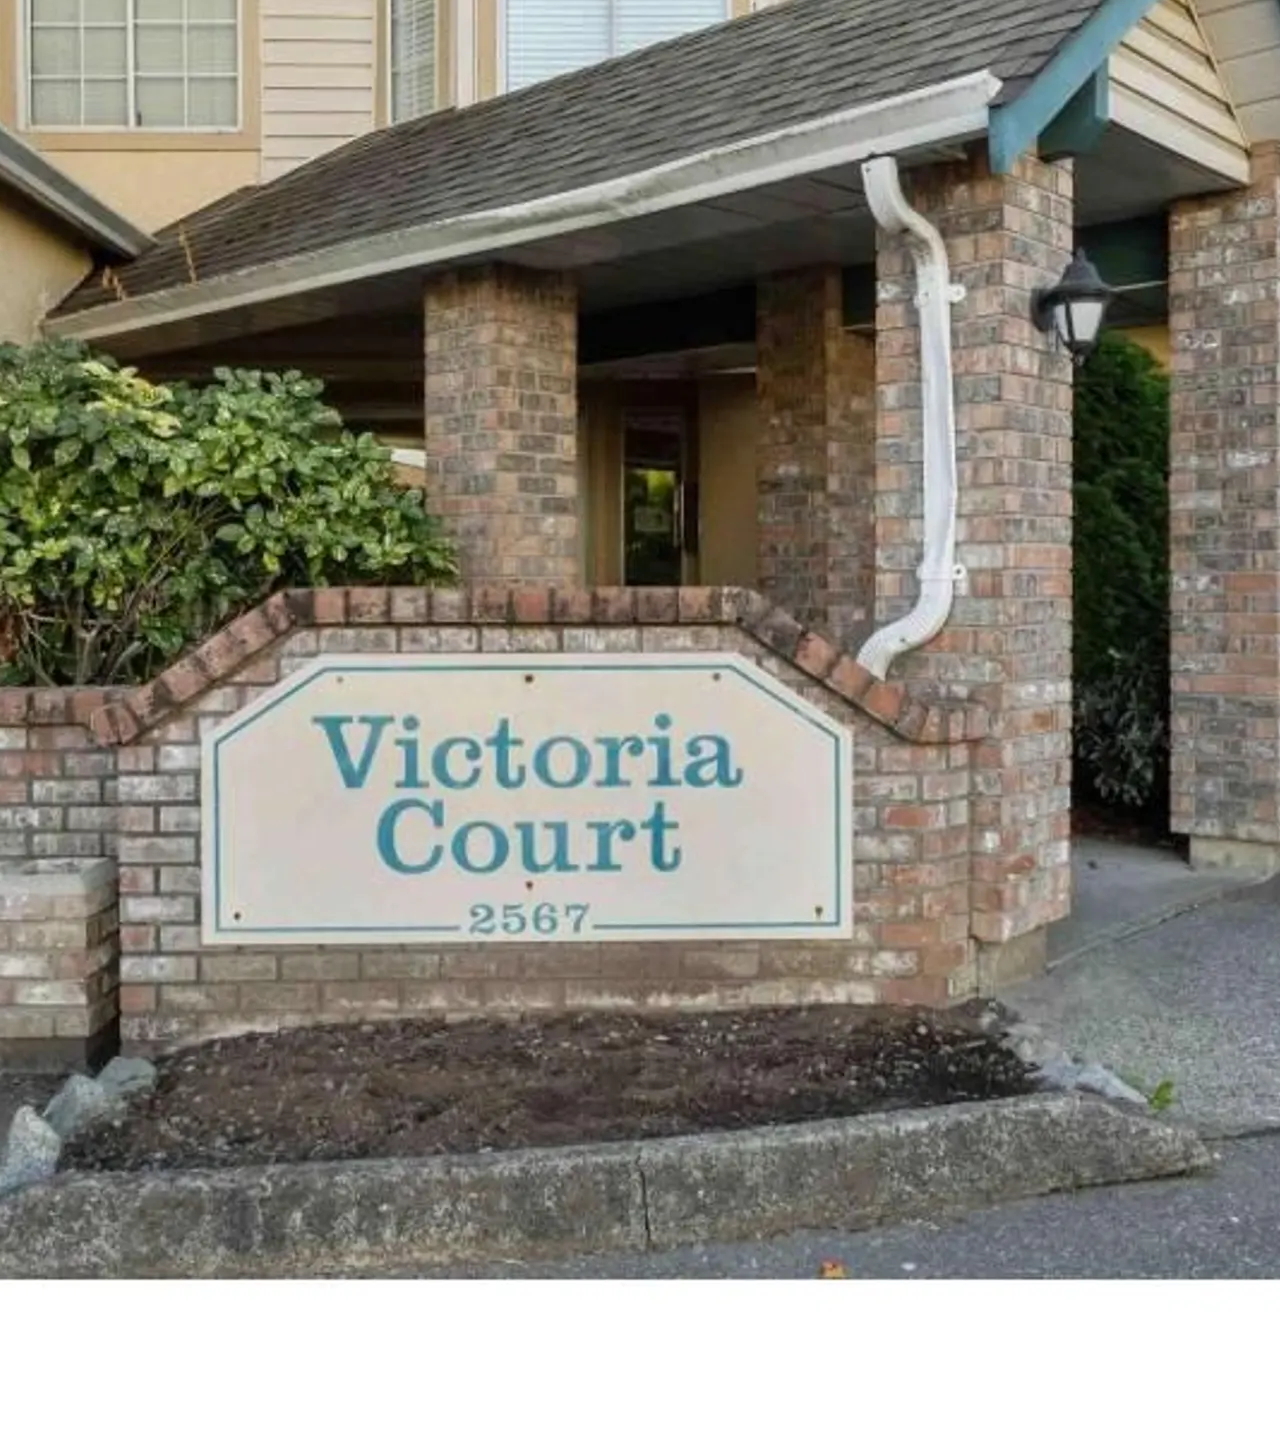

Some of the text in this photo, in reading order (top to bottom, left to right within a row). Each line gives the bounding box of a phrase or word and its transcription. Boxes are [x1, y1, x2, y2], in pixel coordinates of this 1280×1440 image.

[312, 712, 743, 791] Victoria
[375, 797, 682, 875] Court
[468, 902, 591, 936] 2567
